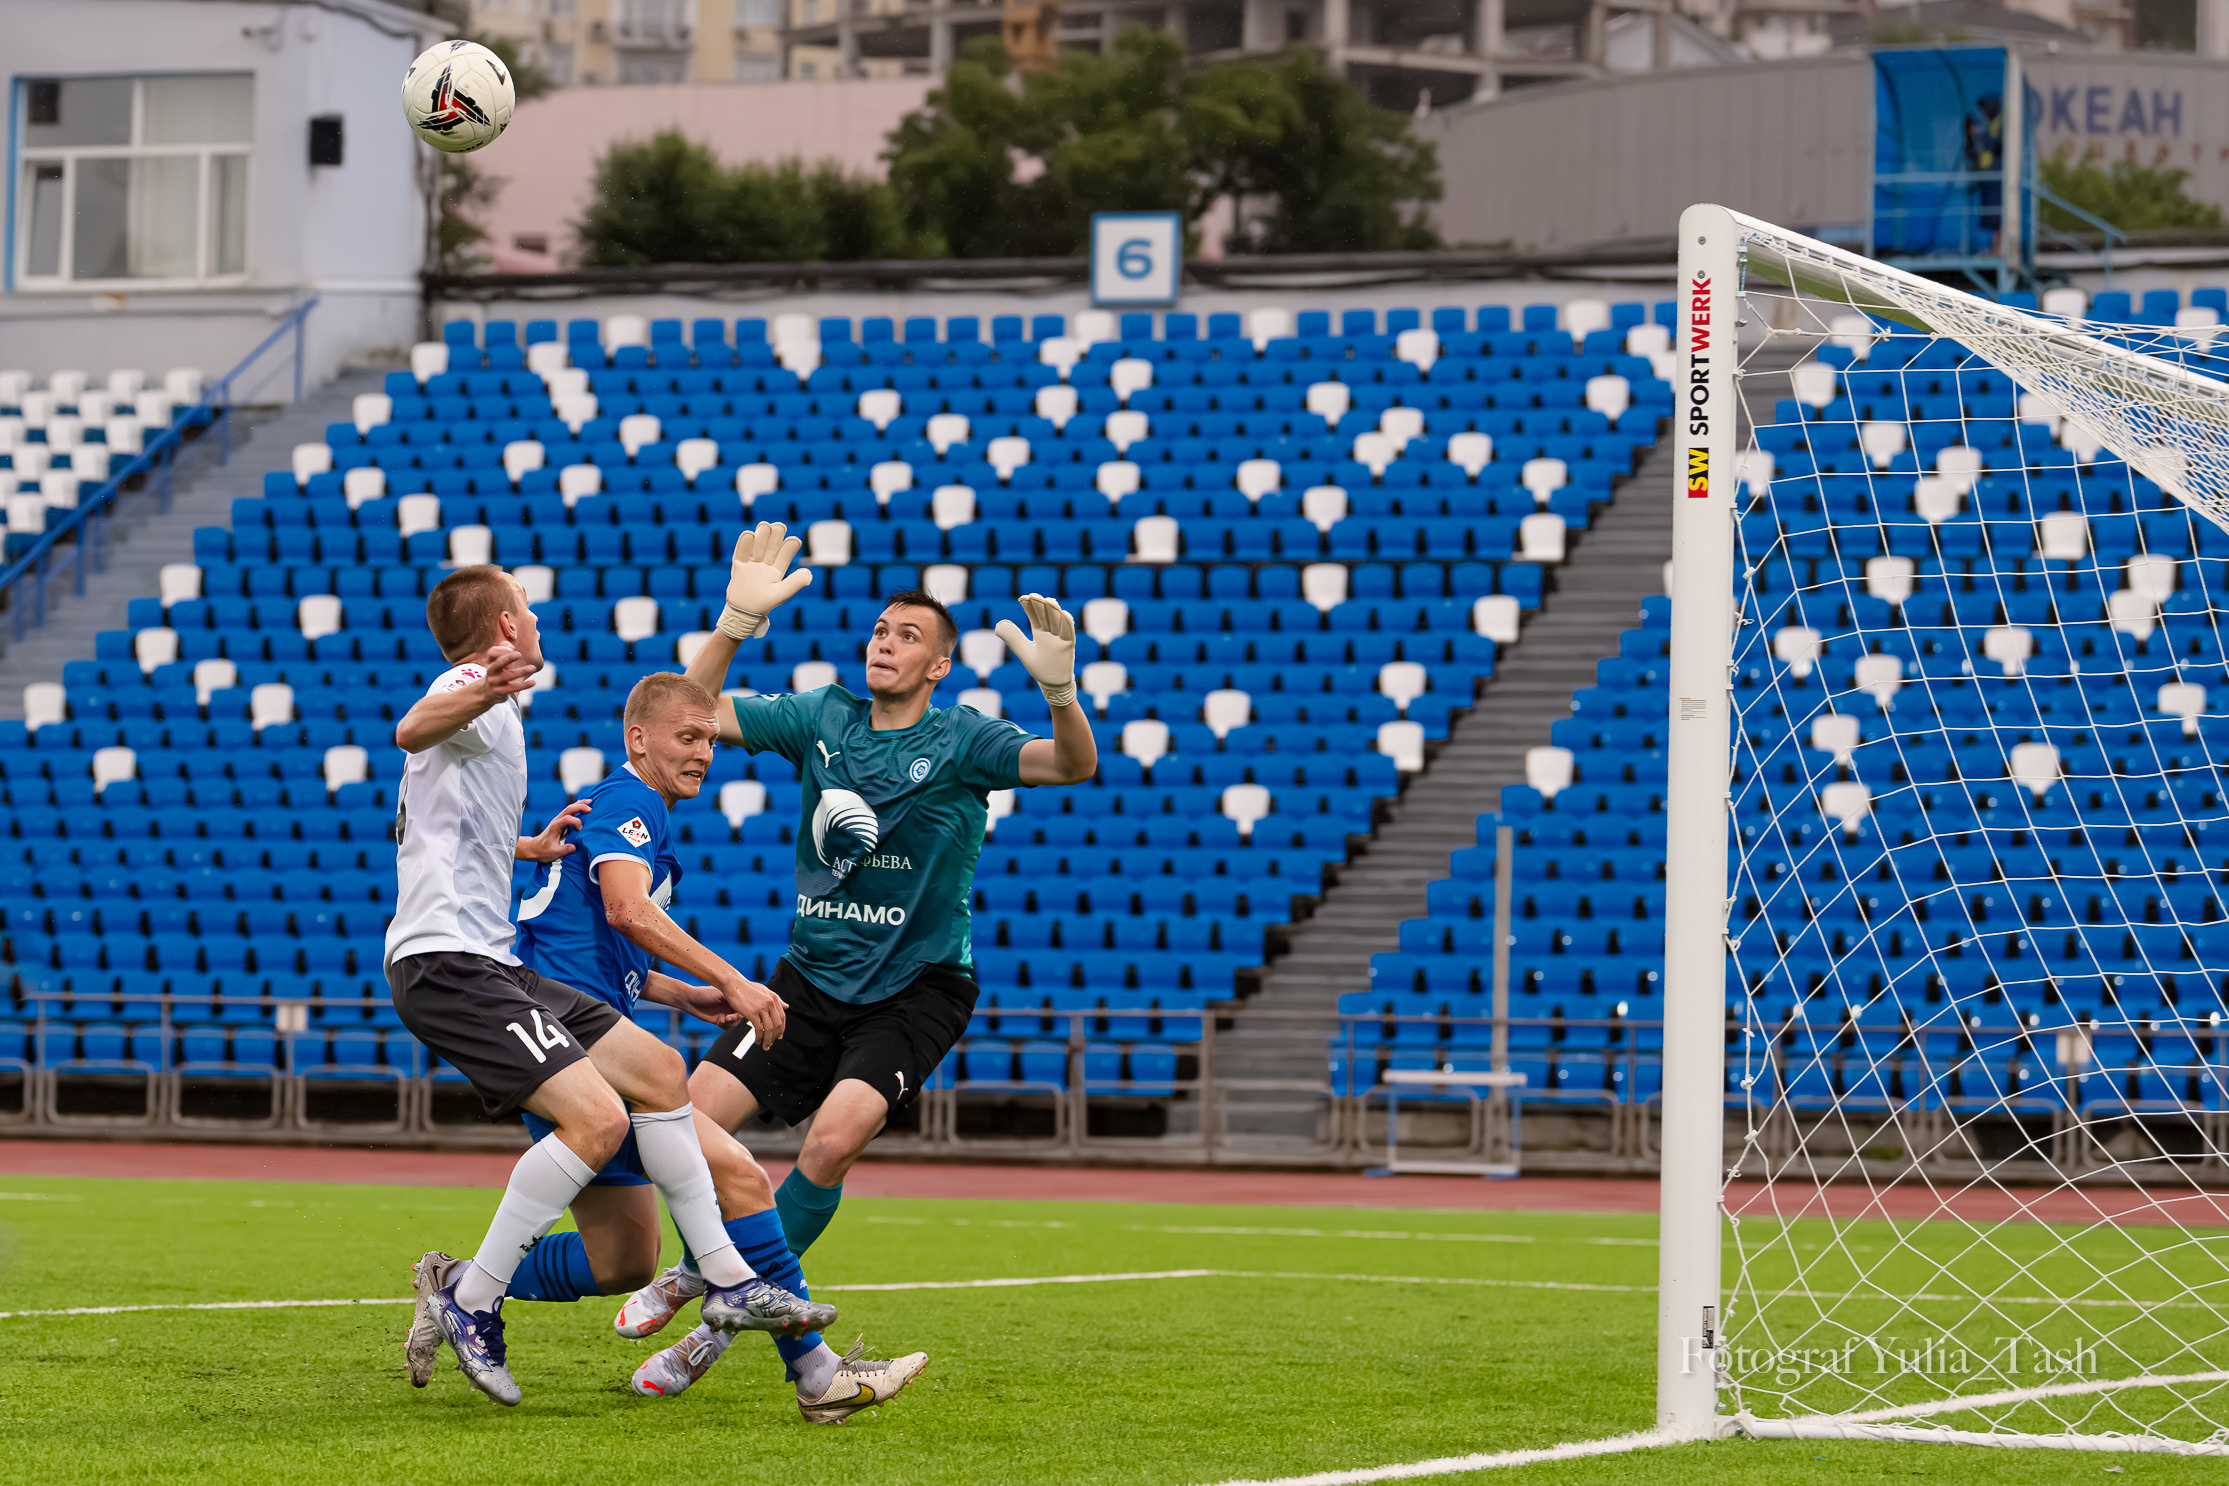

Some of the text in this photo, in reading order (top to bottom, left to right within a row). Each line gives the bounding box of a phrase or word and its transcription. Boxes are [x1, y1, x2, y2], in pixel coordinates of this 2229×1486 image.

[1115, 238, 1154, 281] 6
[1690, 277, 1711, 436] SPORTWERK
[796, 893, 906, 926] ДИНАМО
[506, 1008, 571, 1064] 14
